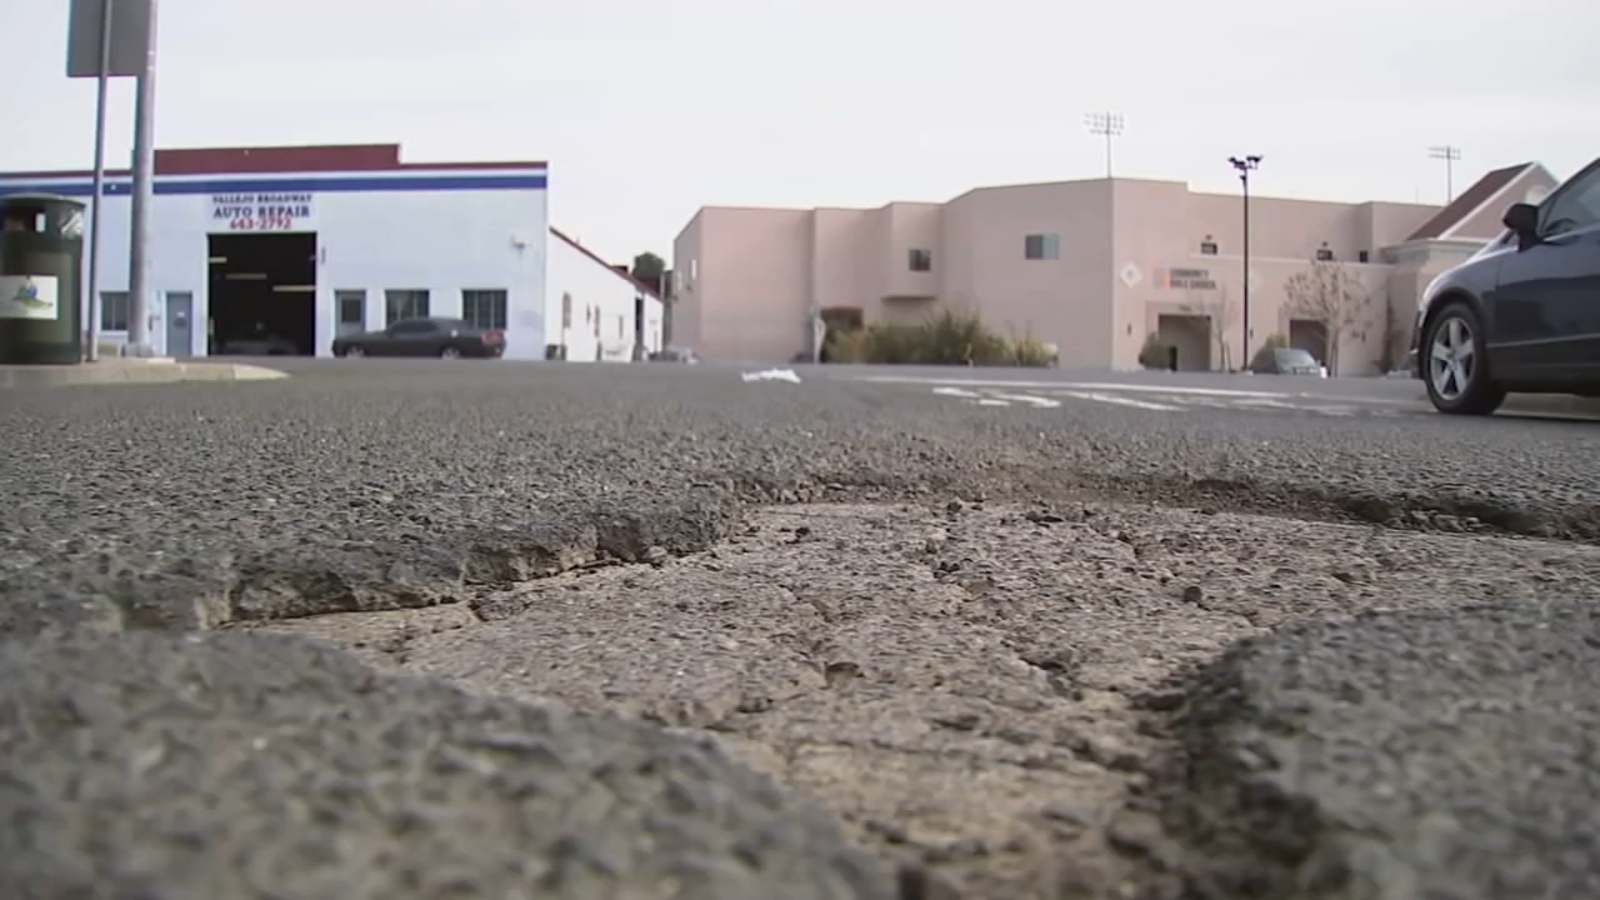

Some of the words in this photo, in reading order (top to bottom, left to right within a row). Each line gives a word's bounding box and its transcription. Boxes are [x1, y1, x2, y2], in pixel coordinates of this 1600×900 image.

[213, 194, 255, 204] VALLEJO
[257, 193, 312, 203] BROADWAY
[213, 206, 253, 219] AUTO
[258, 205, 310, 218] REPAIR
[229, 217, 292, 230] 643-2792
